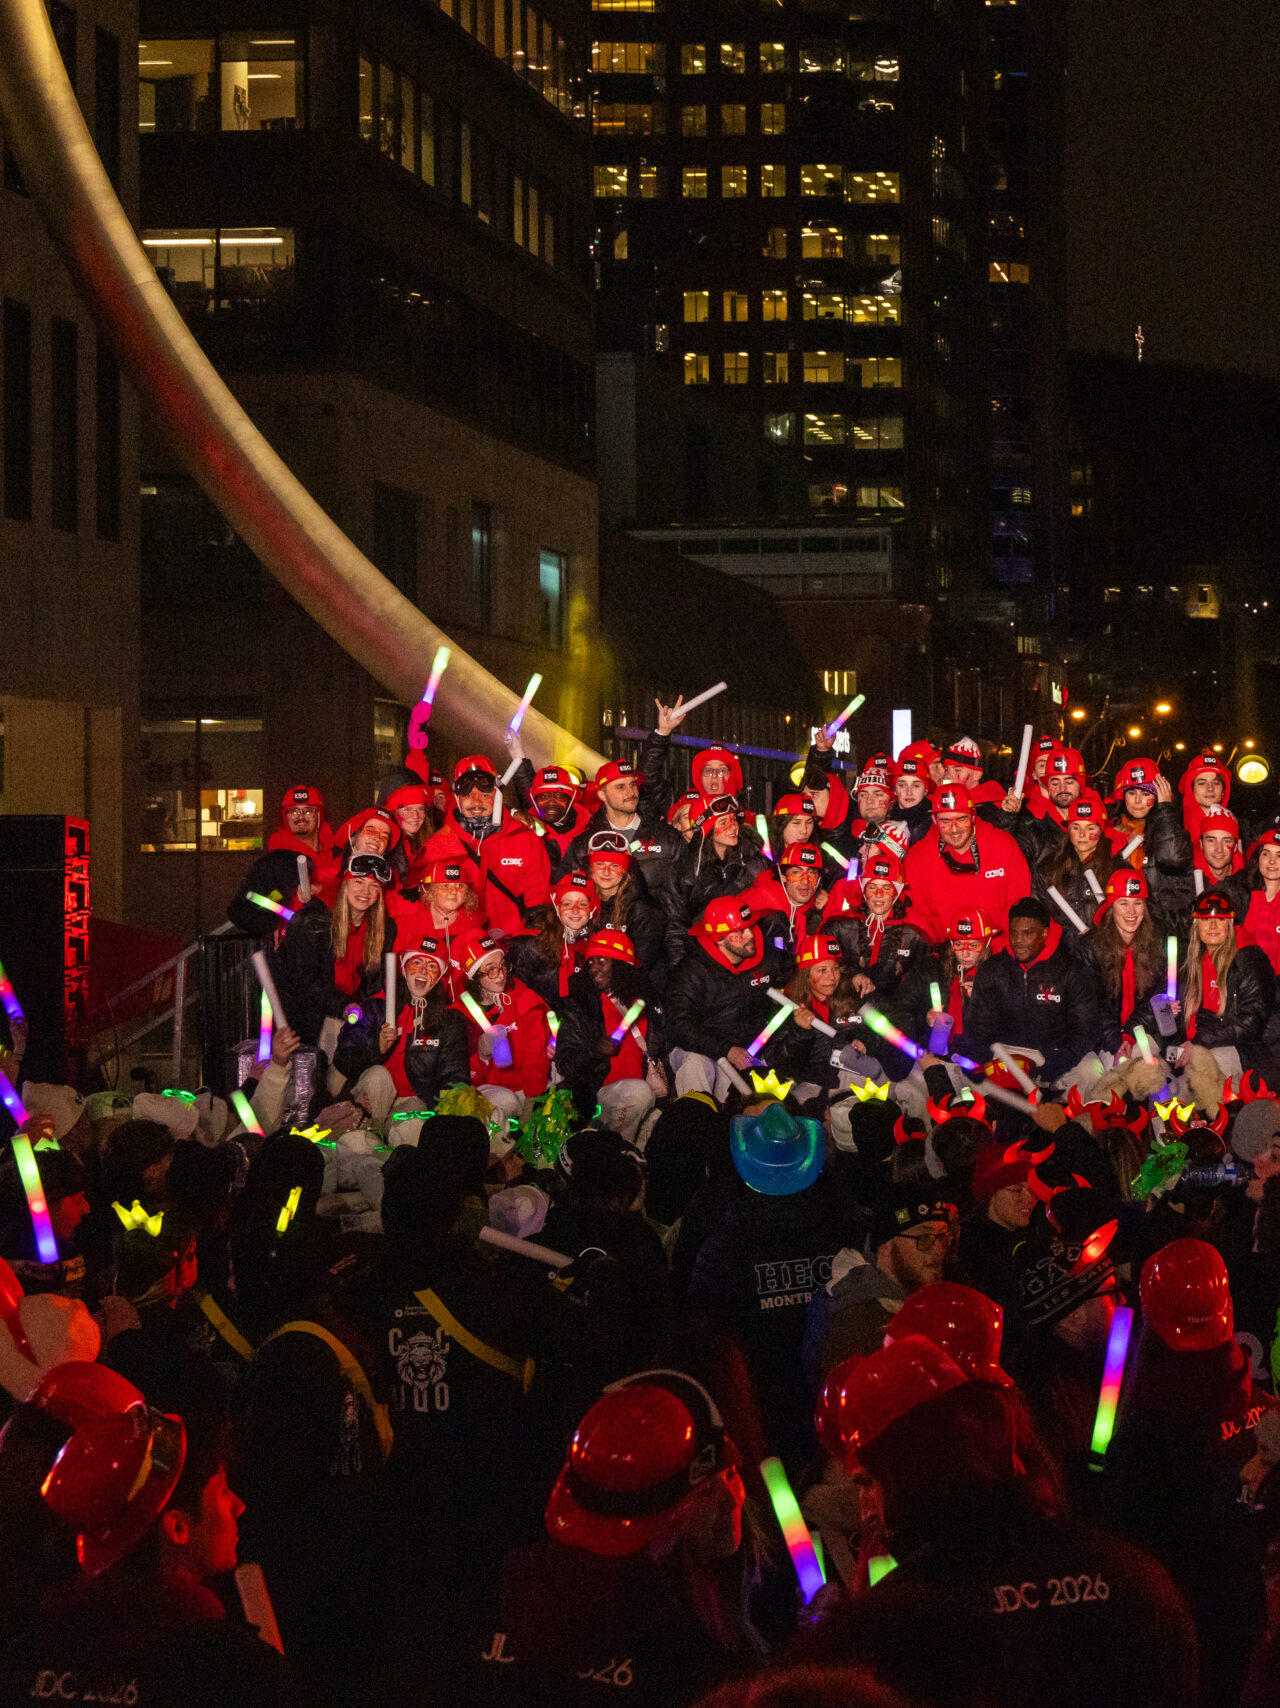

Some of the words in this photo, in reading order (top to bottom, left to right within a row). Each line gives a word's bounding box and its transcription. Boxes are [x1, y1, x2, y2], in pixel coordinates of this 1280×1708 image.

[619, 764, 632, 772] ESG
[377, 810, 390, 819] ESG
[802, 853, 815, 861] ESG
[573, 877, 586, 885] ESG
[1127, 883, 1140, 891] ESG
[422, 941, 436, 949] ESG
[481, 940, 494, 948] ESG
[754, 1255, 833, 1295] HEC
[992, 1581, 1040, 1614] JDC
[1047, 1572, 1111, 1607] 2026
